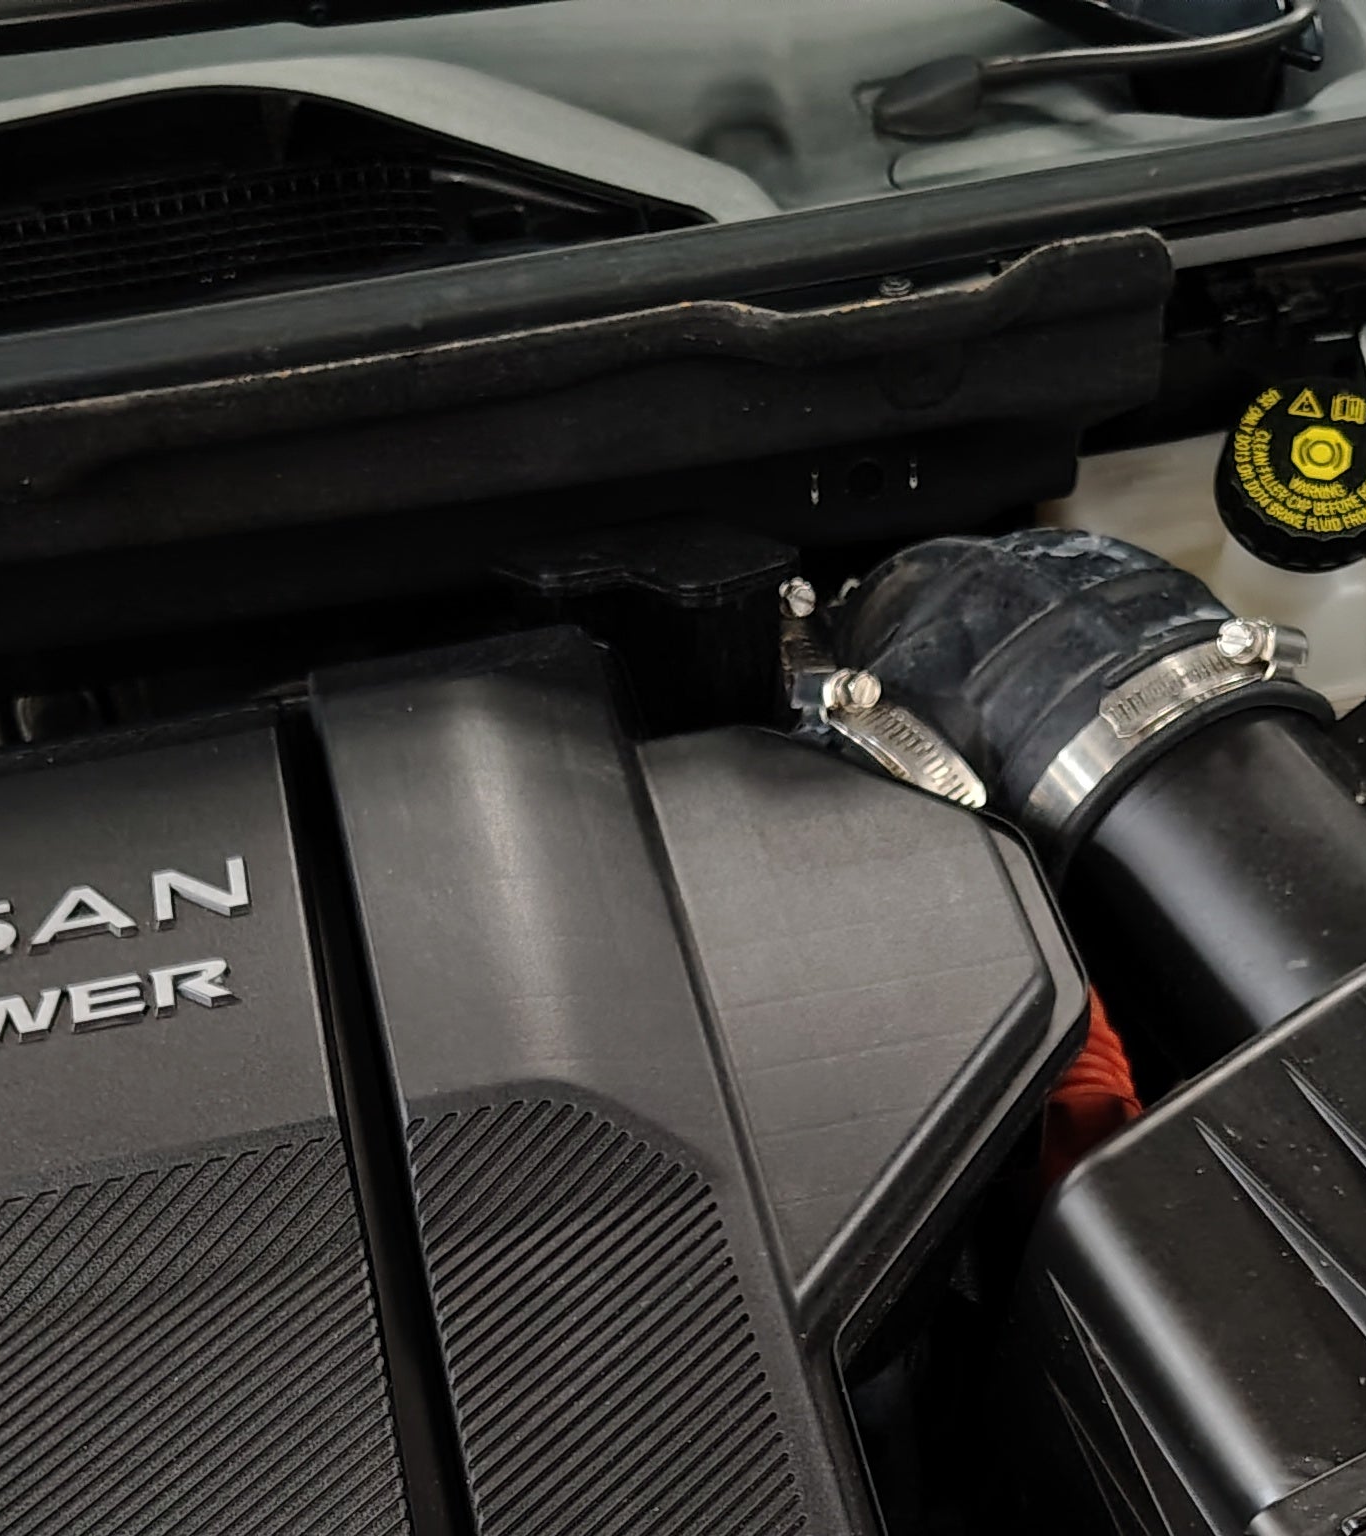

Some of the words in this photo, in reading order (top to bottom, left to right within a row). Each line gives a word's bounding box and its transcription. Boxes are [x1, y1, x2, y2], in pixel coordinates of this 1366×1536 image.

[1240, 405, 1264, 435] ONLY
[1253, 428, 1272, 466] CLEAN
[1237, 462, 1257, 481] OR
[1257, 466, 1291, 501] FILLER
[1288, 476, 1347, 499] WARNING
[1266, 502, 1306, 529] BRAKE
[1286, 494, 1313, 515] CAP
[1313, 494, 1362, 516] BEFORE
[1306, 517, 1343, 532] FLUID
